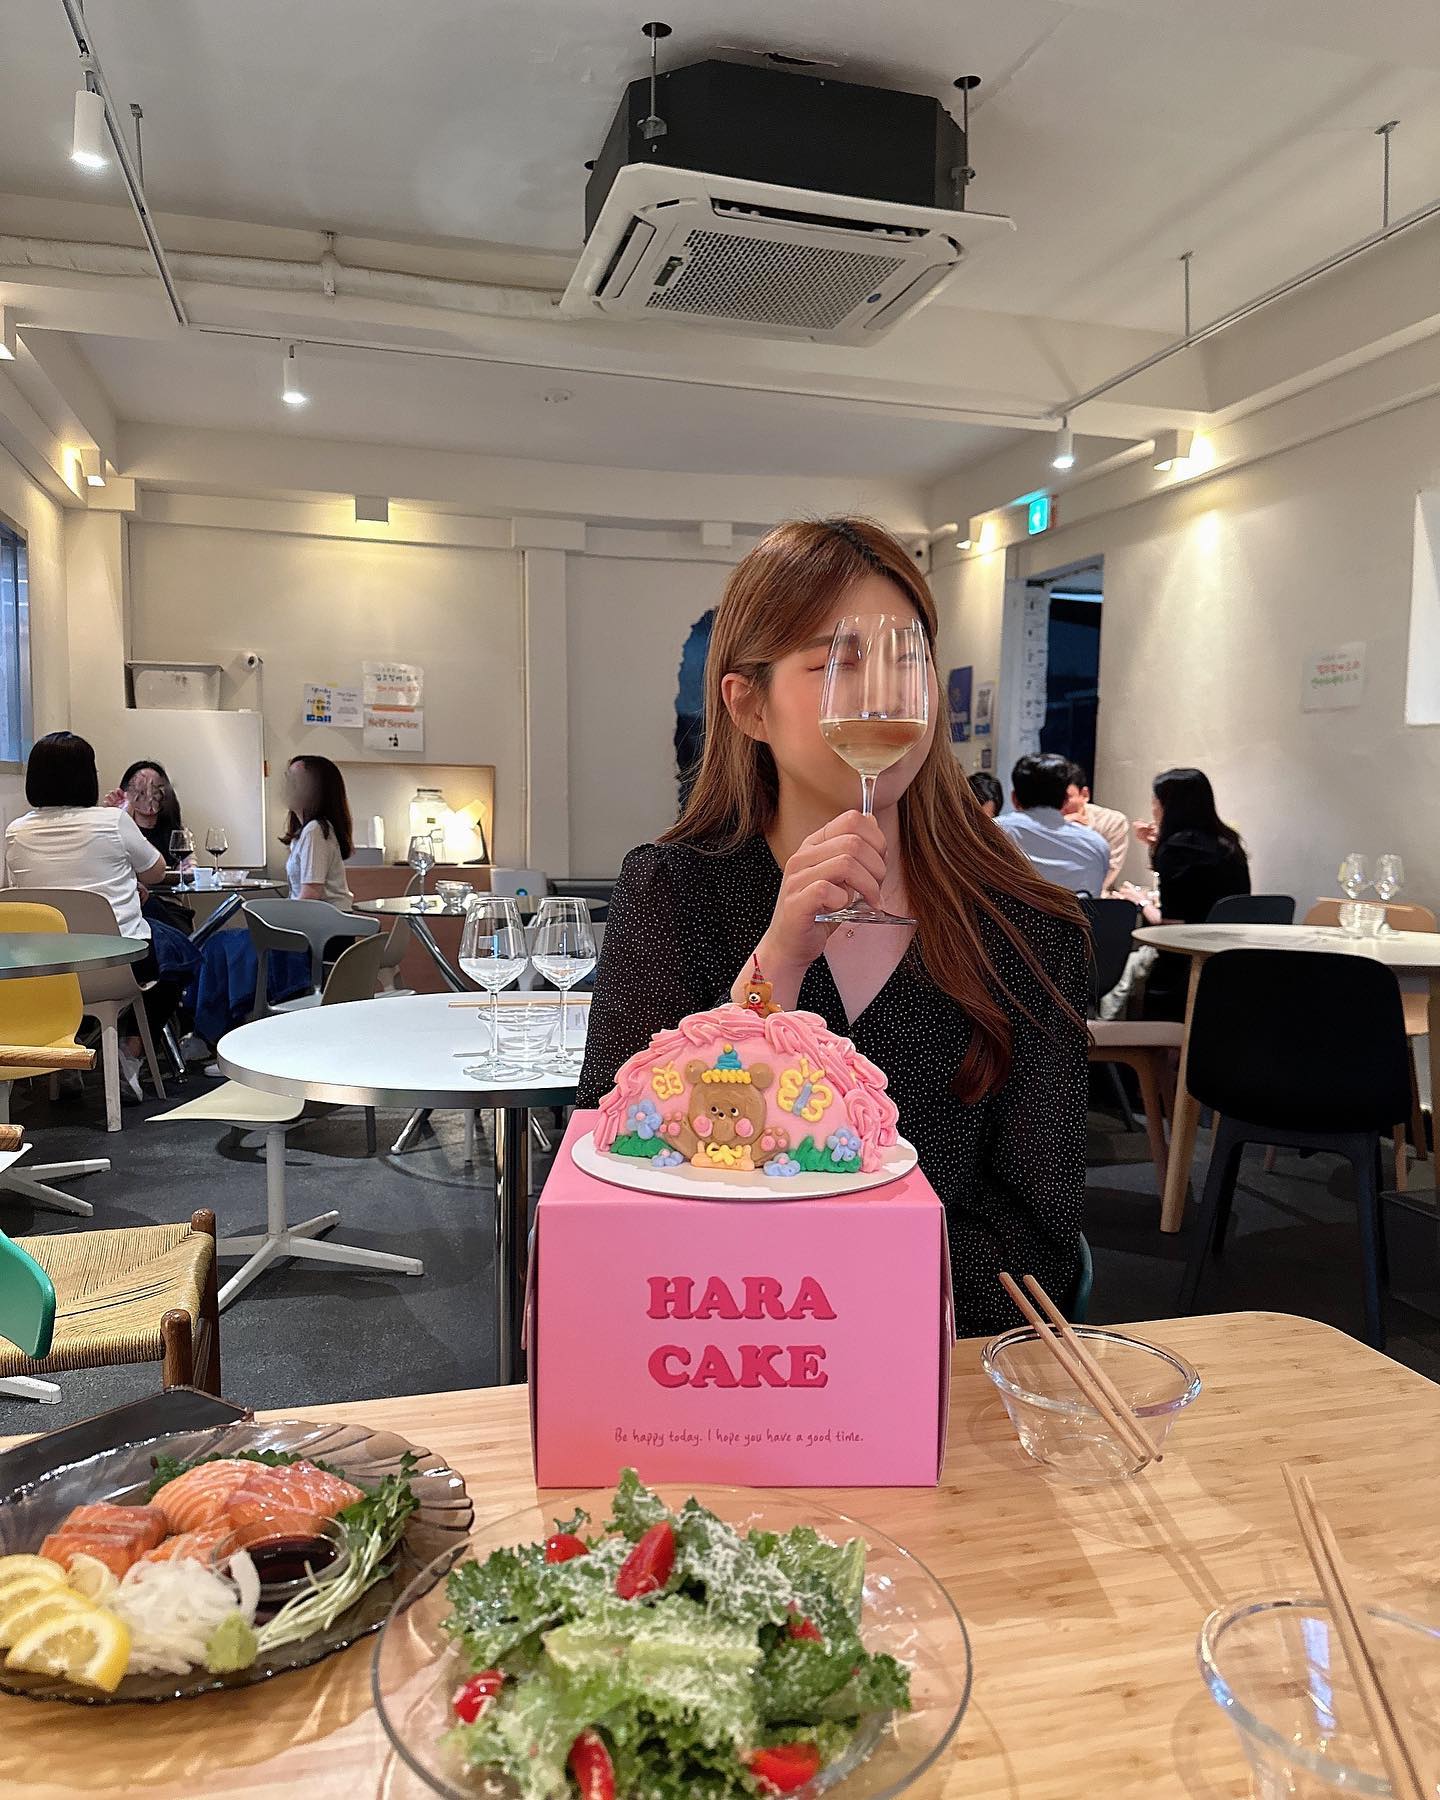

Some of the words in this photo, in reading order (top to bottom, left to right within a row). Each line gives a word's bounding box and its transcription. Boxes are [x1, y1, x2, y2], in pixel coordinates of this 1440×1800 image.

[647, 1276, 838, 1320] HARA
[648, 1345, 829, 1388] CAKE
[614, 1427, 628, 1443] Be
[632, 1428, 664, 1447] happy
[669, 1428, 703, 1447] today.
[707, 1428, 712, 1442] I
[716, 1427, 740, 1446] hope
[744, 1432, 762, 1447] you
[766, 1428, 792, 1443] have
[796, 1433, 804, 1442] a
[805, 1428, 832, 1447] good
[836, 1430, 864, 1442] time.
